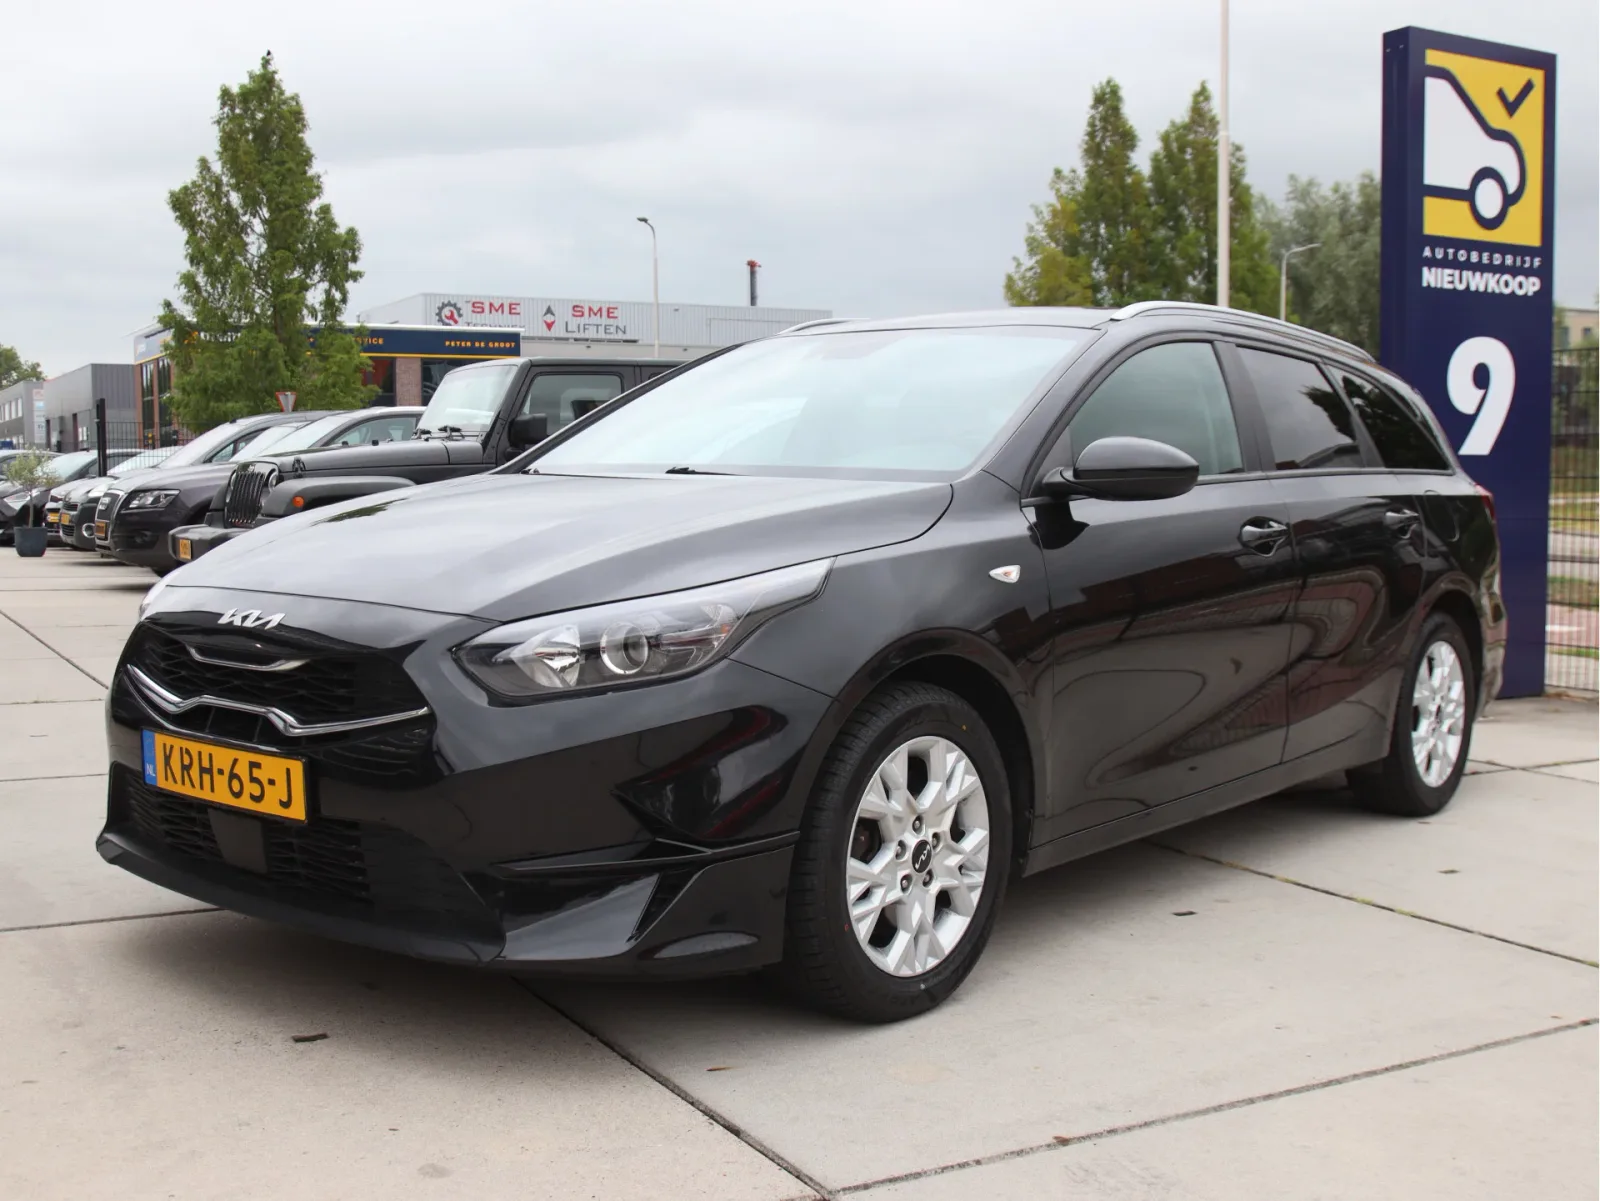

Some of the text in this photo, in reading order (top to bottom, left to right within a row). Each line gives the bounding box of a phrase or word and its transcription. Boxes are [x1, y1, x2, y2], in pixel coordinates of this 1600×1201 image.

[1422, 246, 1541, 268] AUTOBEDRIJF
[1421, 266, 1541, 296] NIEUWKOOP
[471, 301, 521, 315] SME
[572, 304, 618, 319] SME
[565, 321, 627, 334] LIFTEN
[1446, 335, 1516, 456] 9
[217, 608, 286, 630] KIA
[146, 762, 156, 777] NL
[162, 742, 293, 810] KRH-65-J
